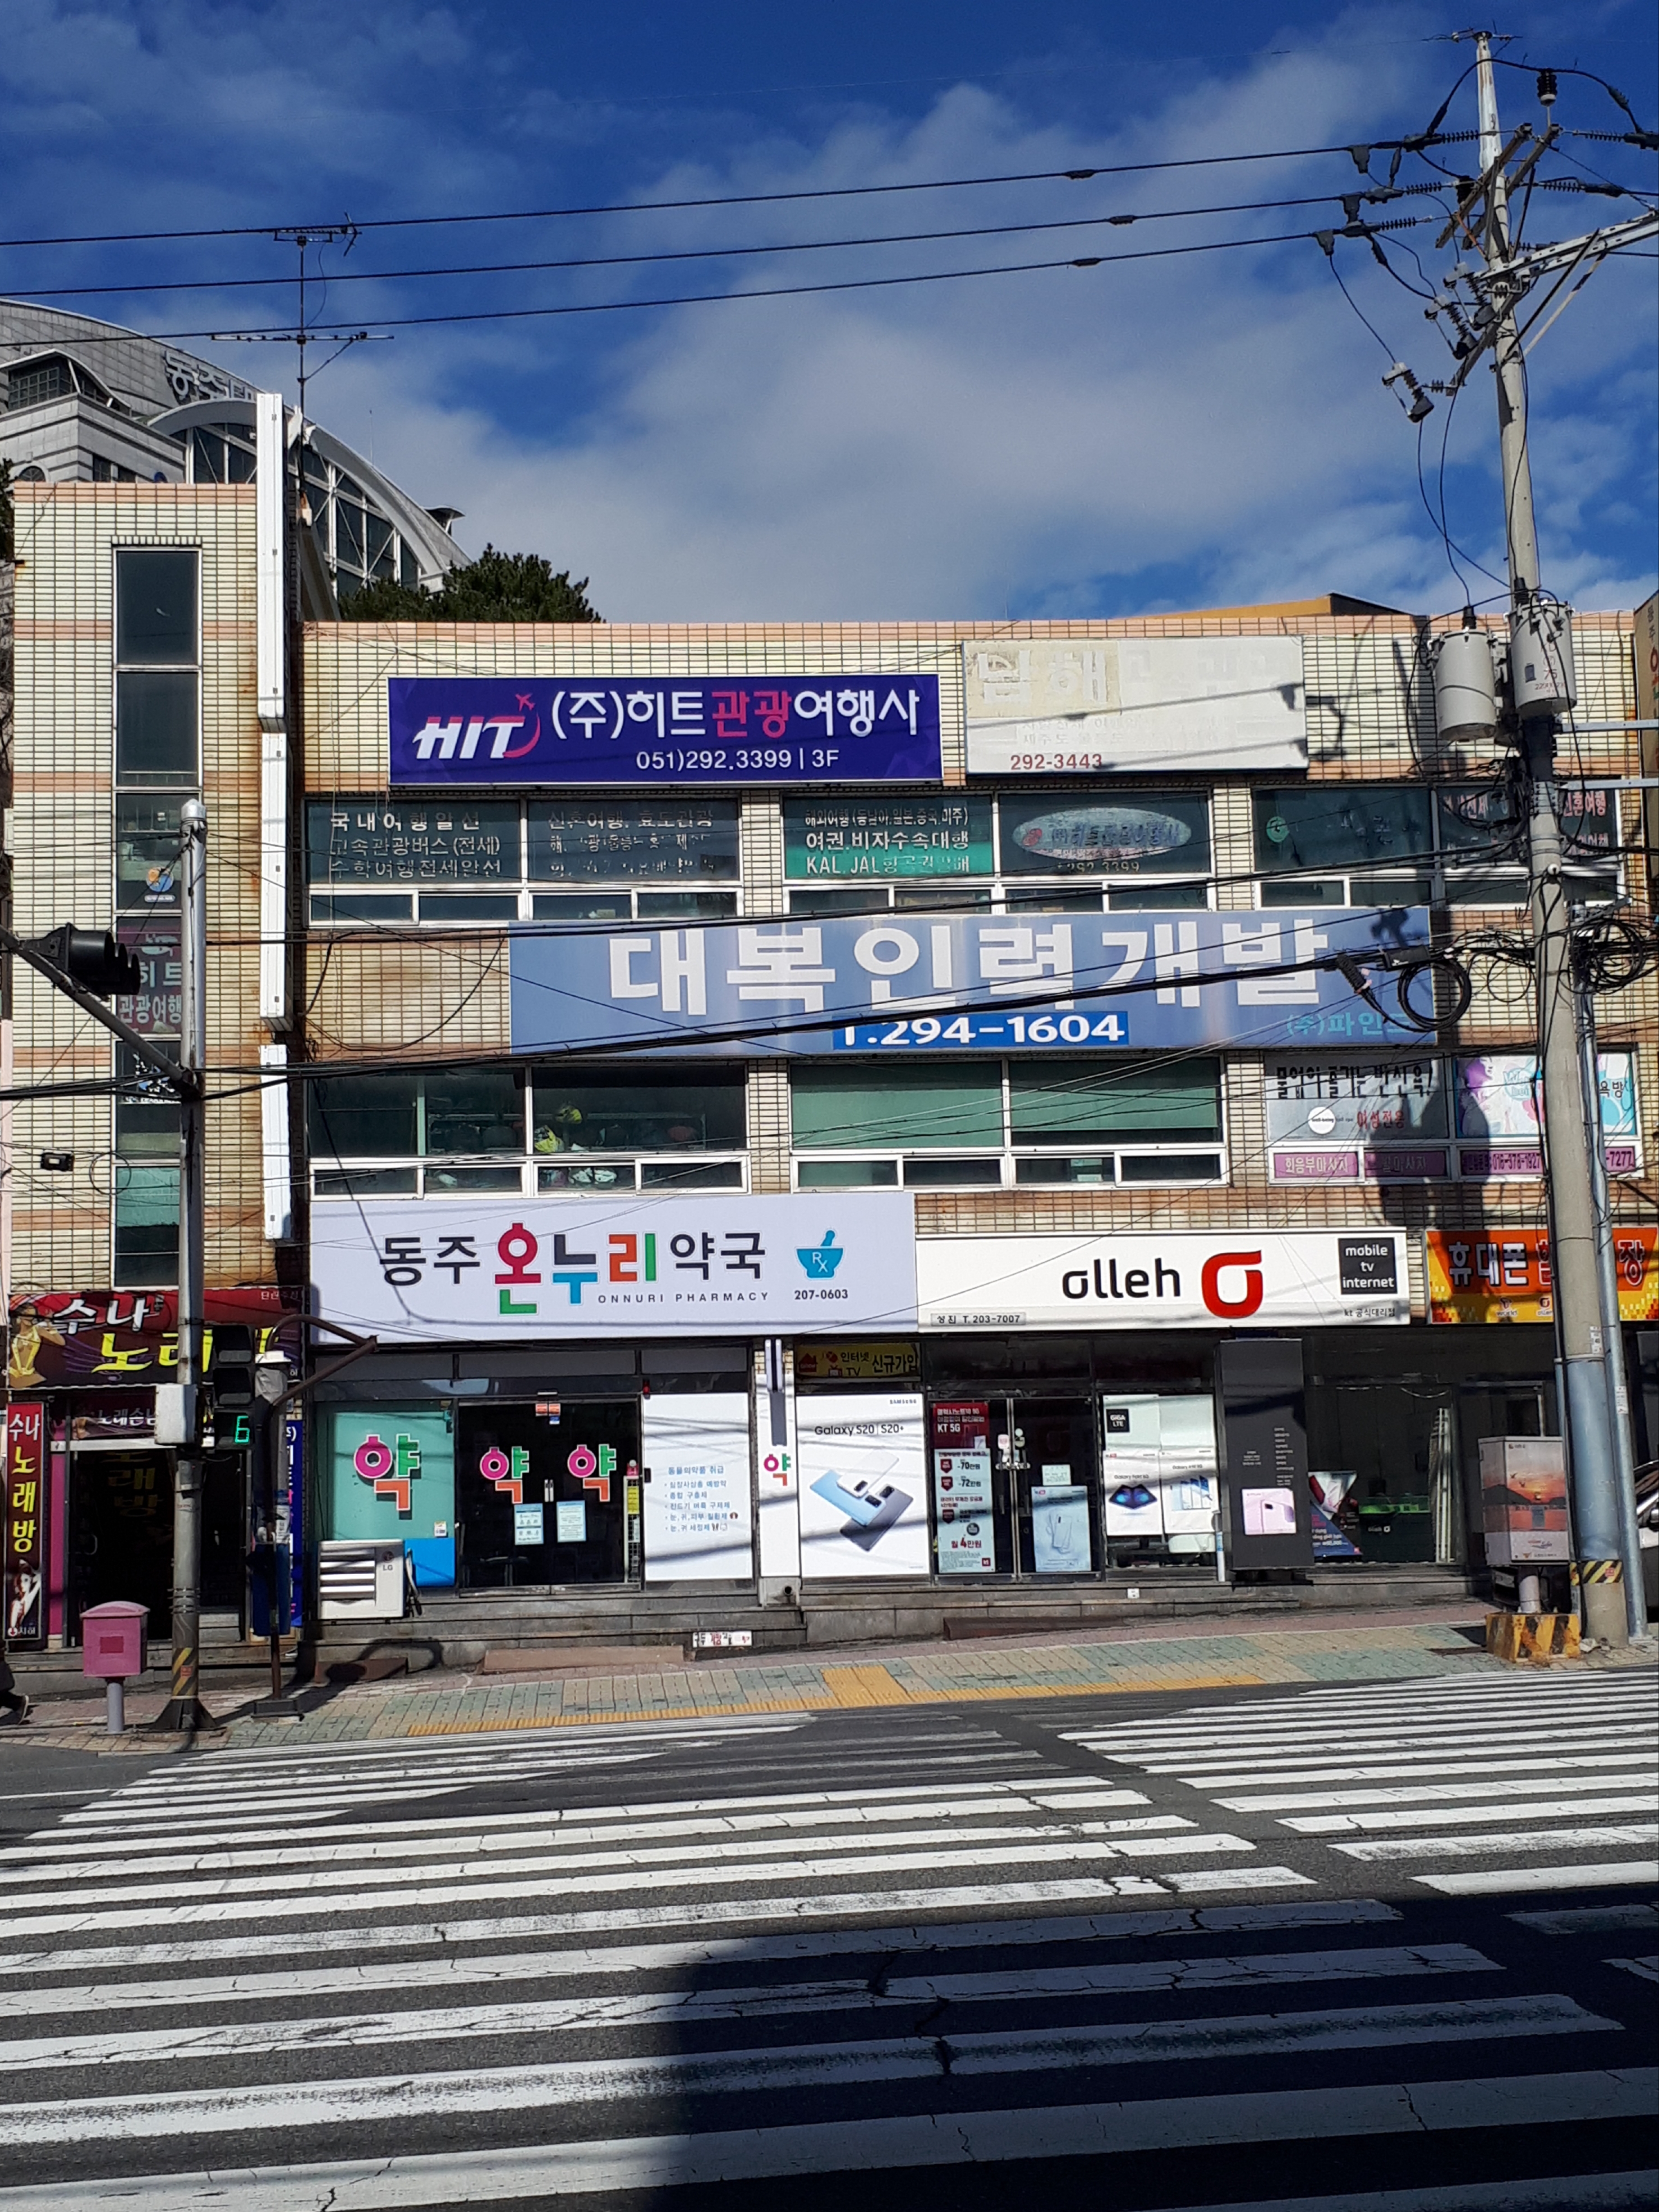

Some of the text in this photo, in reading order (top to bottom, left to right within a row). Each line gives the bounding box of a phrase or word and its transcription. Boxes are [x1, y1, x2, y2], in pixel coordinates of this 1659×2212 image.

[552, 688, 920, 740] (주)히트관광여행사
[413, 716, 525, 759] HIT
[636, 749, 839, 772] 051)292.3399 3F
[1010, 753, 1102, 771] 292-3443
[609, 918, 1328, 1015] 대복인력개발
[1345, 1244, 1389, 1257] mobile
[1449, 1240, 1528, 1286] 휴대폰
[1061, 1258, 1181, 1299] olleh
[1361, 1261, 1375, 1273] tv
[794, 1289, 849, 1300] 207-0603
[1342, 1276, 1395, 1289] internet
[598, 1292, 769, 1303] ONNURI PHARMACY
[53, 1297, 149, 1335] 수나
[841, 1351, 870, 1363] 인터넷
[845, 1367, 861, 1377] TV
[8, 1413, 40, 1442] 수나
[235, 1415, 250, 1443] 6
[814, 1423, 904, 1437] Galaxy S20 S20+
[938, 1423, 961, 1433] KT 5G
[353, 1433, 420, 1511] 약
[480, 1445, 530, 1505] 약
[567, 1443, 617, 1502] 약
[764, 1453, 792, 1486] 약
[11, 1446, 37, 1553] 노래방
